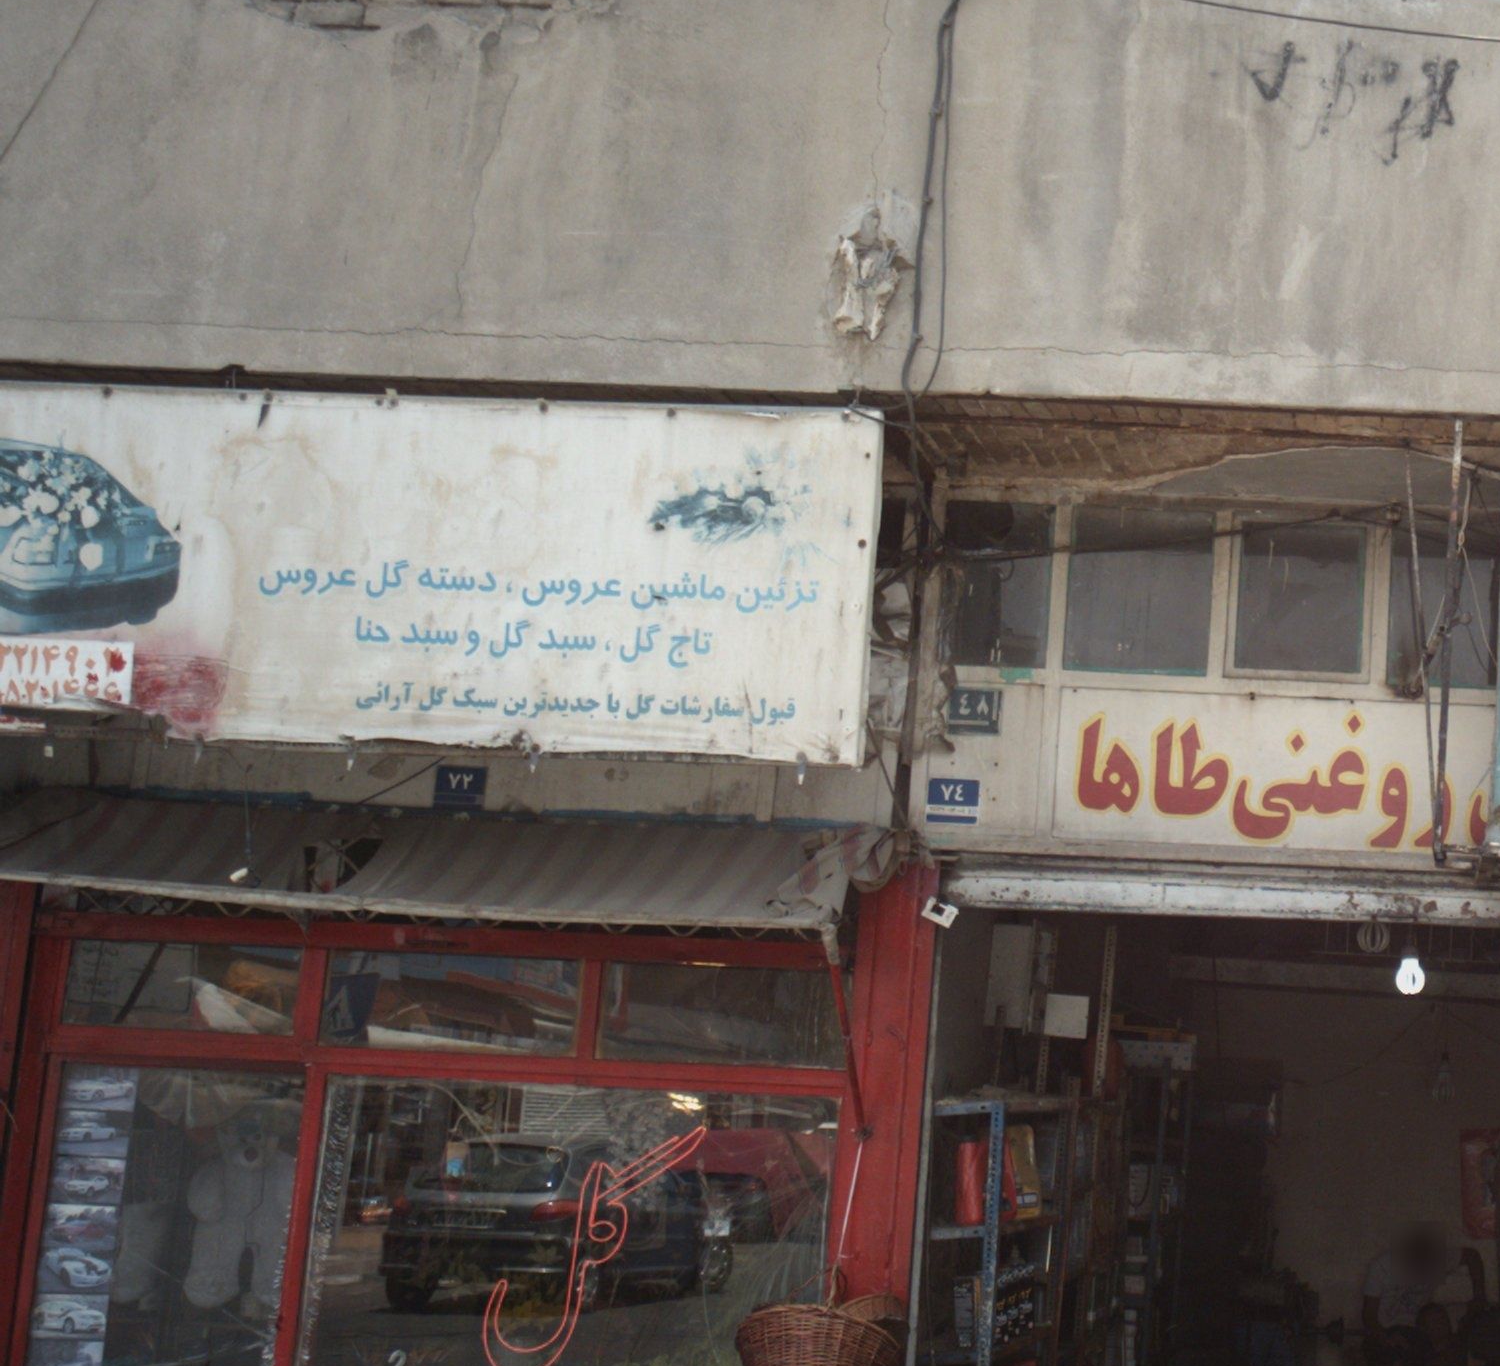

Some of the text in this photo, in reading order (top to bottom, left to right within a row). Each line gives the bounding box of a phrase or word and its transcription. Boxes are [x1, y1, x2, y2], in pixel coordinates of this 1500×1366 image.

[259, 567, 357, 596] عروس
[365, 560, 409, 598] گل
[417, 566, 498, 593] دسته
[522, 578, 621, 607] عروس
[631, 572, 726, 610] ماشین
[736, 576, 820, 613] تزئین
[355, 616, 391, 643] حنا
[399, 623, 458, 653] سبد
[464, 628, 481, 657] و
[489, 620, 530, 658] گل
[538, 629, 596, 659] سبد
[619, 624, 661, 663] گل
[667, 629, 713, 668] تاج
[452, 688, 498, 713] سبک
[503, 691, 600, 719] جدیدترین
[607, 693, 620, 718] با
[660, 695, 745, 723] سفارشات
[750, 697, 796, 725] قبول
[1076, 712, 1230, 817] طاها
[1231, 712, 1453, 849] روغنی
